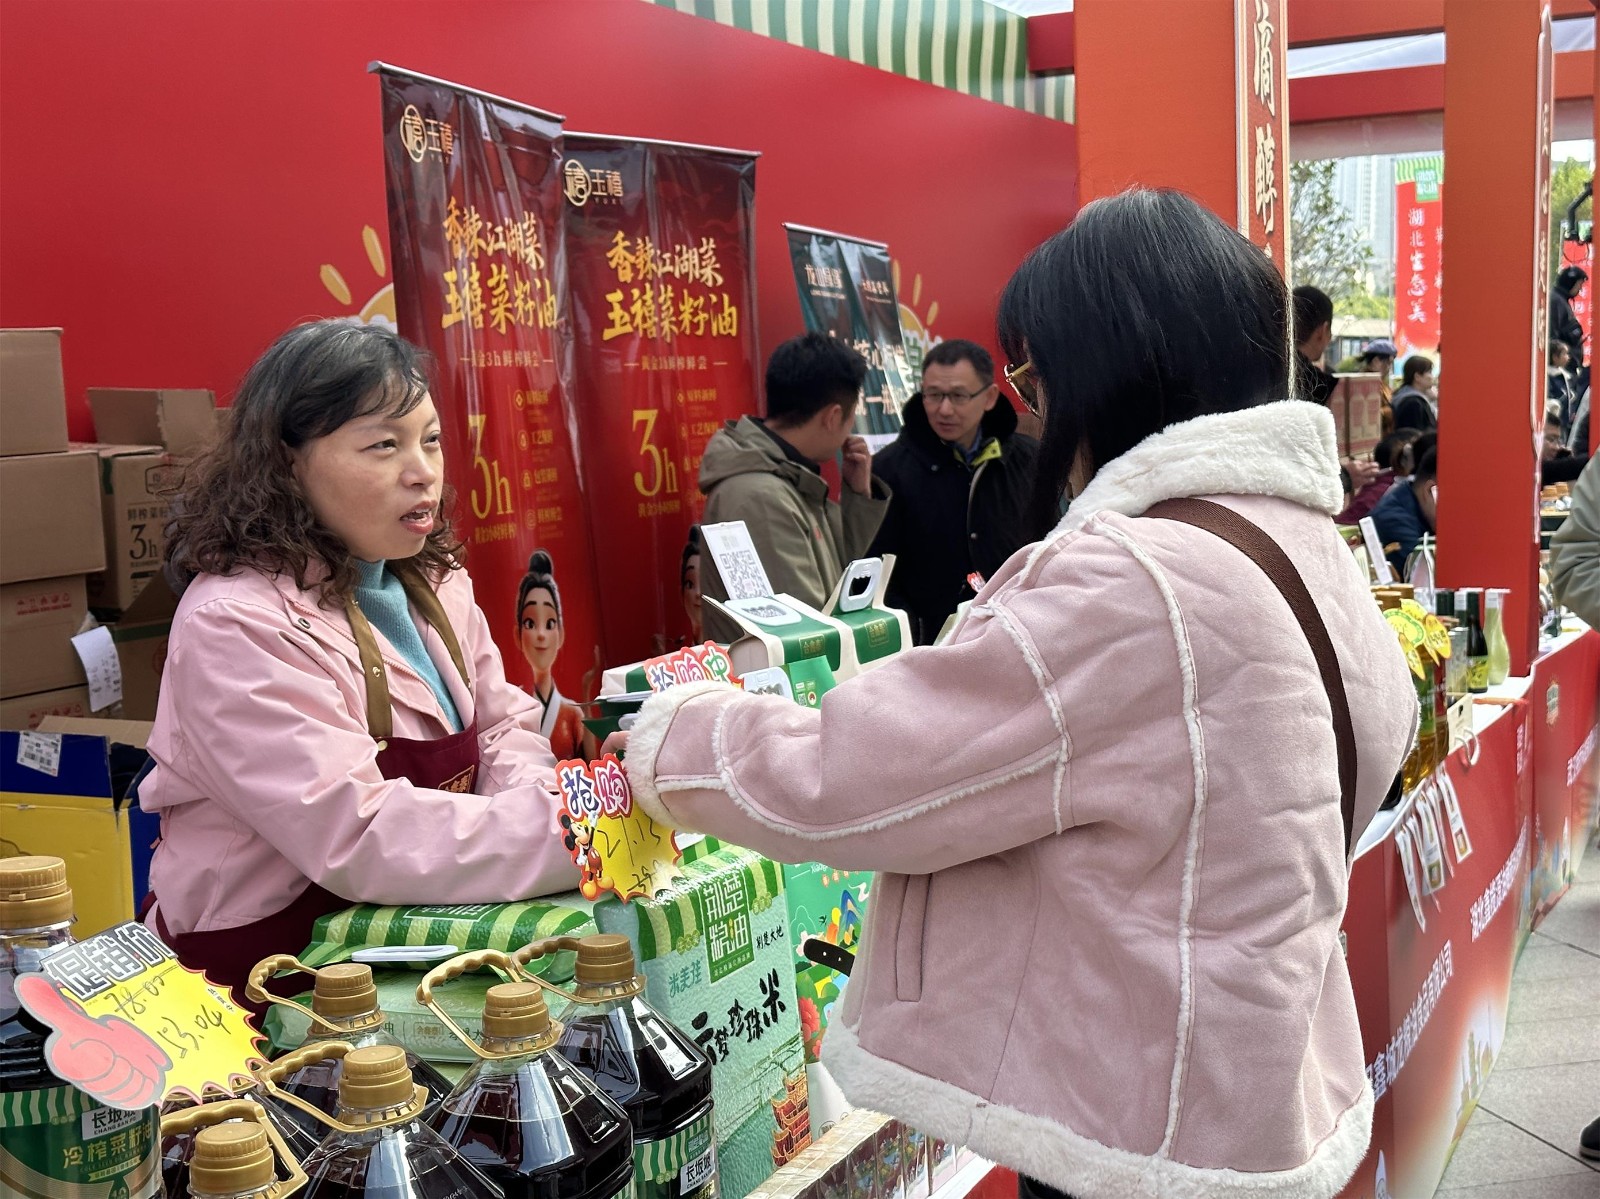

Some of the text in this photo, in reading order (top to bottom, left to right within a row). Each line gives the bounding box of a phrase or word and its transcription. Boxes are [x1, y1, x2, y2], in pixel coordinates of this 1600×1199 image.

[441, 196, 545, 271] 香辣江湖菜
[605, 230, 724, 287] 香辣江湖菜
[441, 261, 557, 335] 玉禧菜籽油
[602, 283, 738, 343] 玉禧菜籽油
[632, 409, 679, 496] 3h
[129, 524, 158, 559] 3h
[709, 913, 750, 963] 粮油
[63, 1120, 153, 1169] 冷榨菜籽油
